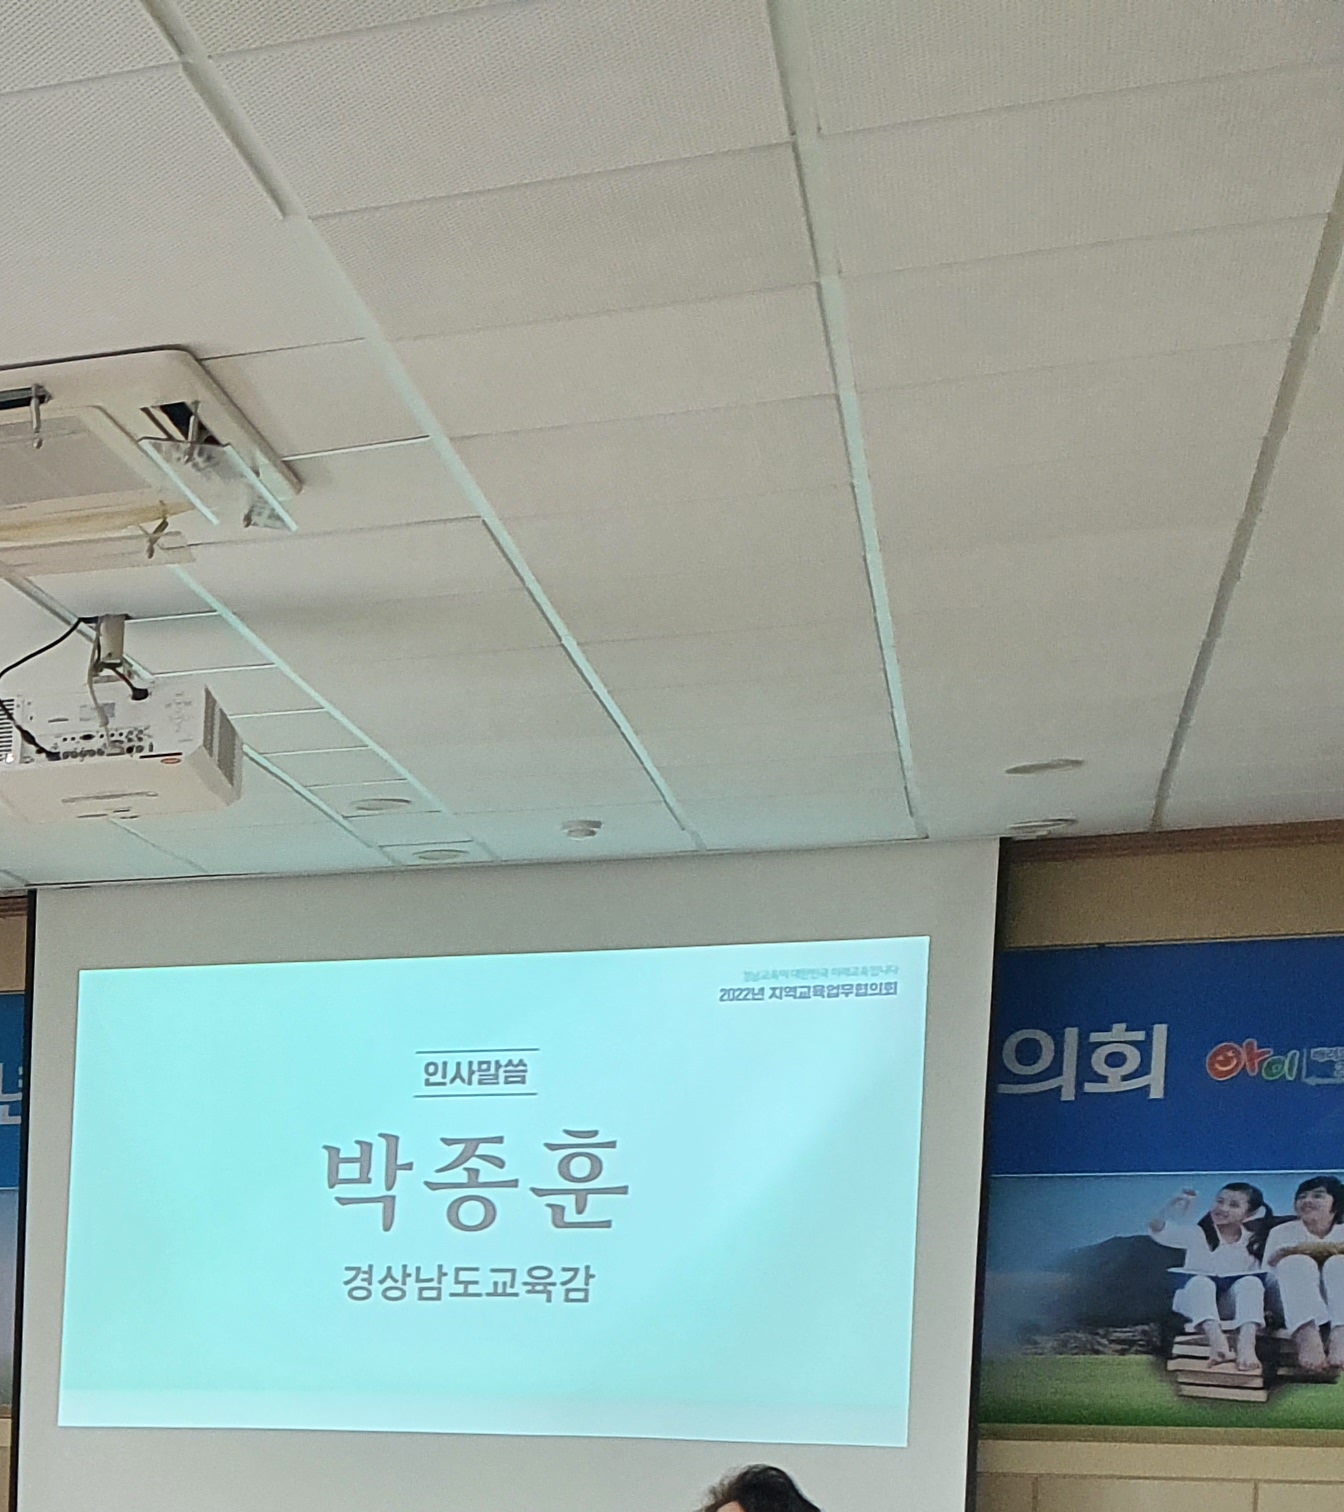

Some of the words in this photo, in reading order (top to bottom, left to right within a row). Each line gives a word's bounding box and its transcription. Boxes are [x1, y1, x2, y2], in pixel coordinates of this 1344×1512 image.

[719, 987, 765, 1002] 2022년
[768, 981, 898, 1001] 지역교육업무협의회
[423, 1058, 529, 1087] 인사말씀
[996, 1022, 1169, 1101] 의회
[322, 1128, 629, 1233] 박종훈
[342, 1263, 596, 1303] 경상남도교육감
